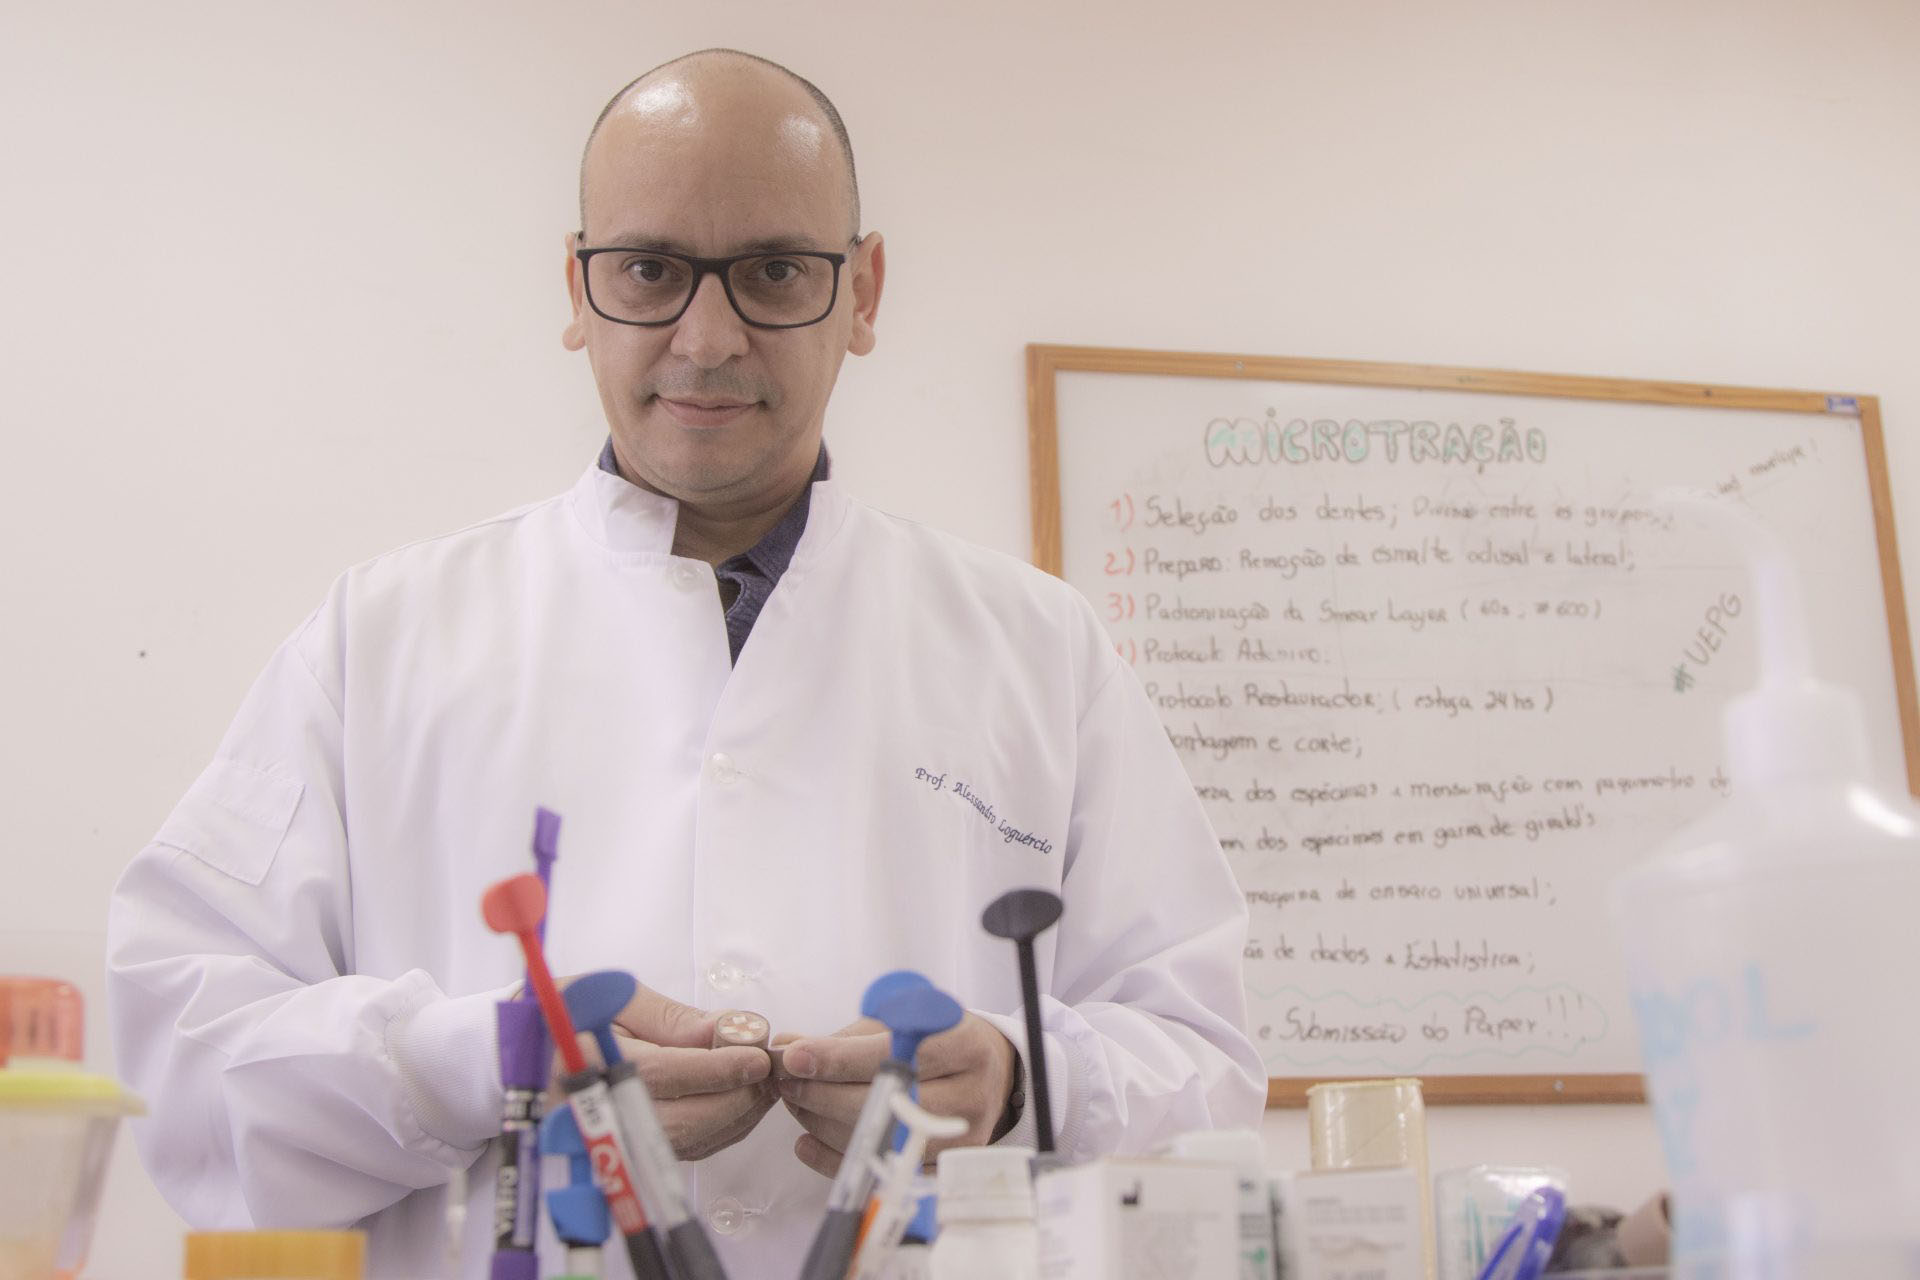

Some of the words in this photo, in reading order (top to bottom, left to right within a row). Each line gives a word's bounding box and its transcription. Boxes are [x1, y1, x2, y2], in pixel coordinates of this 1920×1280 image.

[1110, 493, 1135, 534] 1)
[1144, 494, 1238, 535] Seleção
[1259, 496, 1297, 522] dos
[1337, 544, 1361, 566] de
[1105, 591, 1136, 623] 3)
[1268, 736, 1282, 751] e
[1246, 778, 1277, 802] dos
[915, 767, 948, 790] Prof.
[952, 781, 996, 824] Alessandro
[997, 819, 1053, 854] Loguércio
[1257, 826, 1289, 852] dos
[1274, 933, 1295, 960] de
[1258, 1025, 1271, 1041] e
[1422, 1010, 1449, 1042] do
